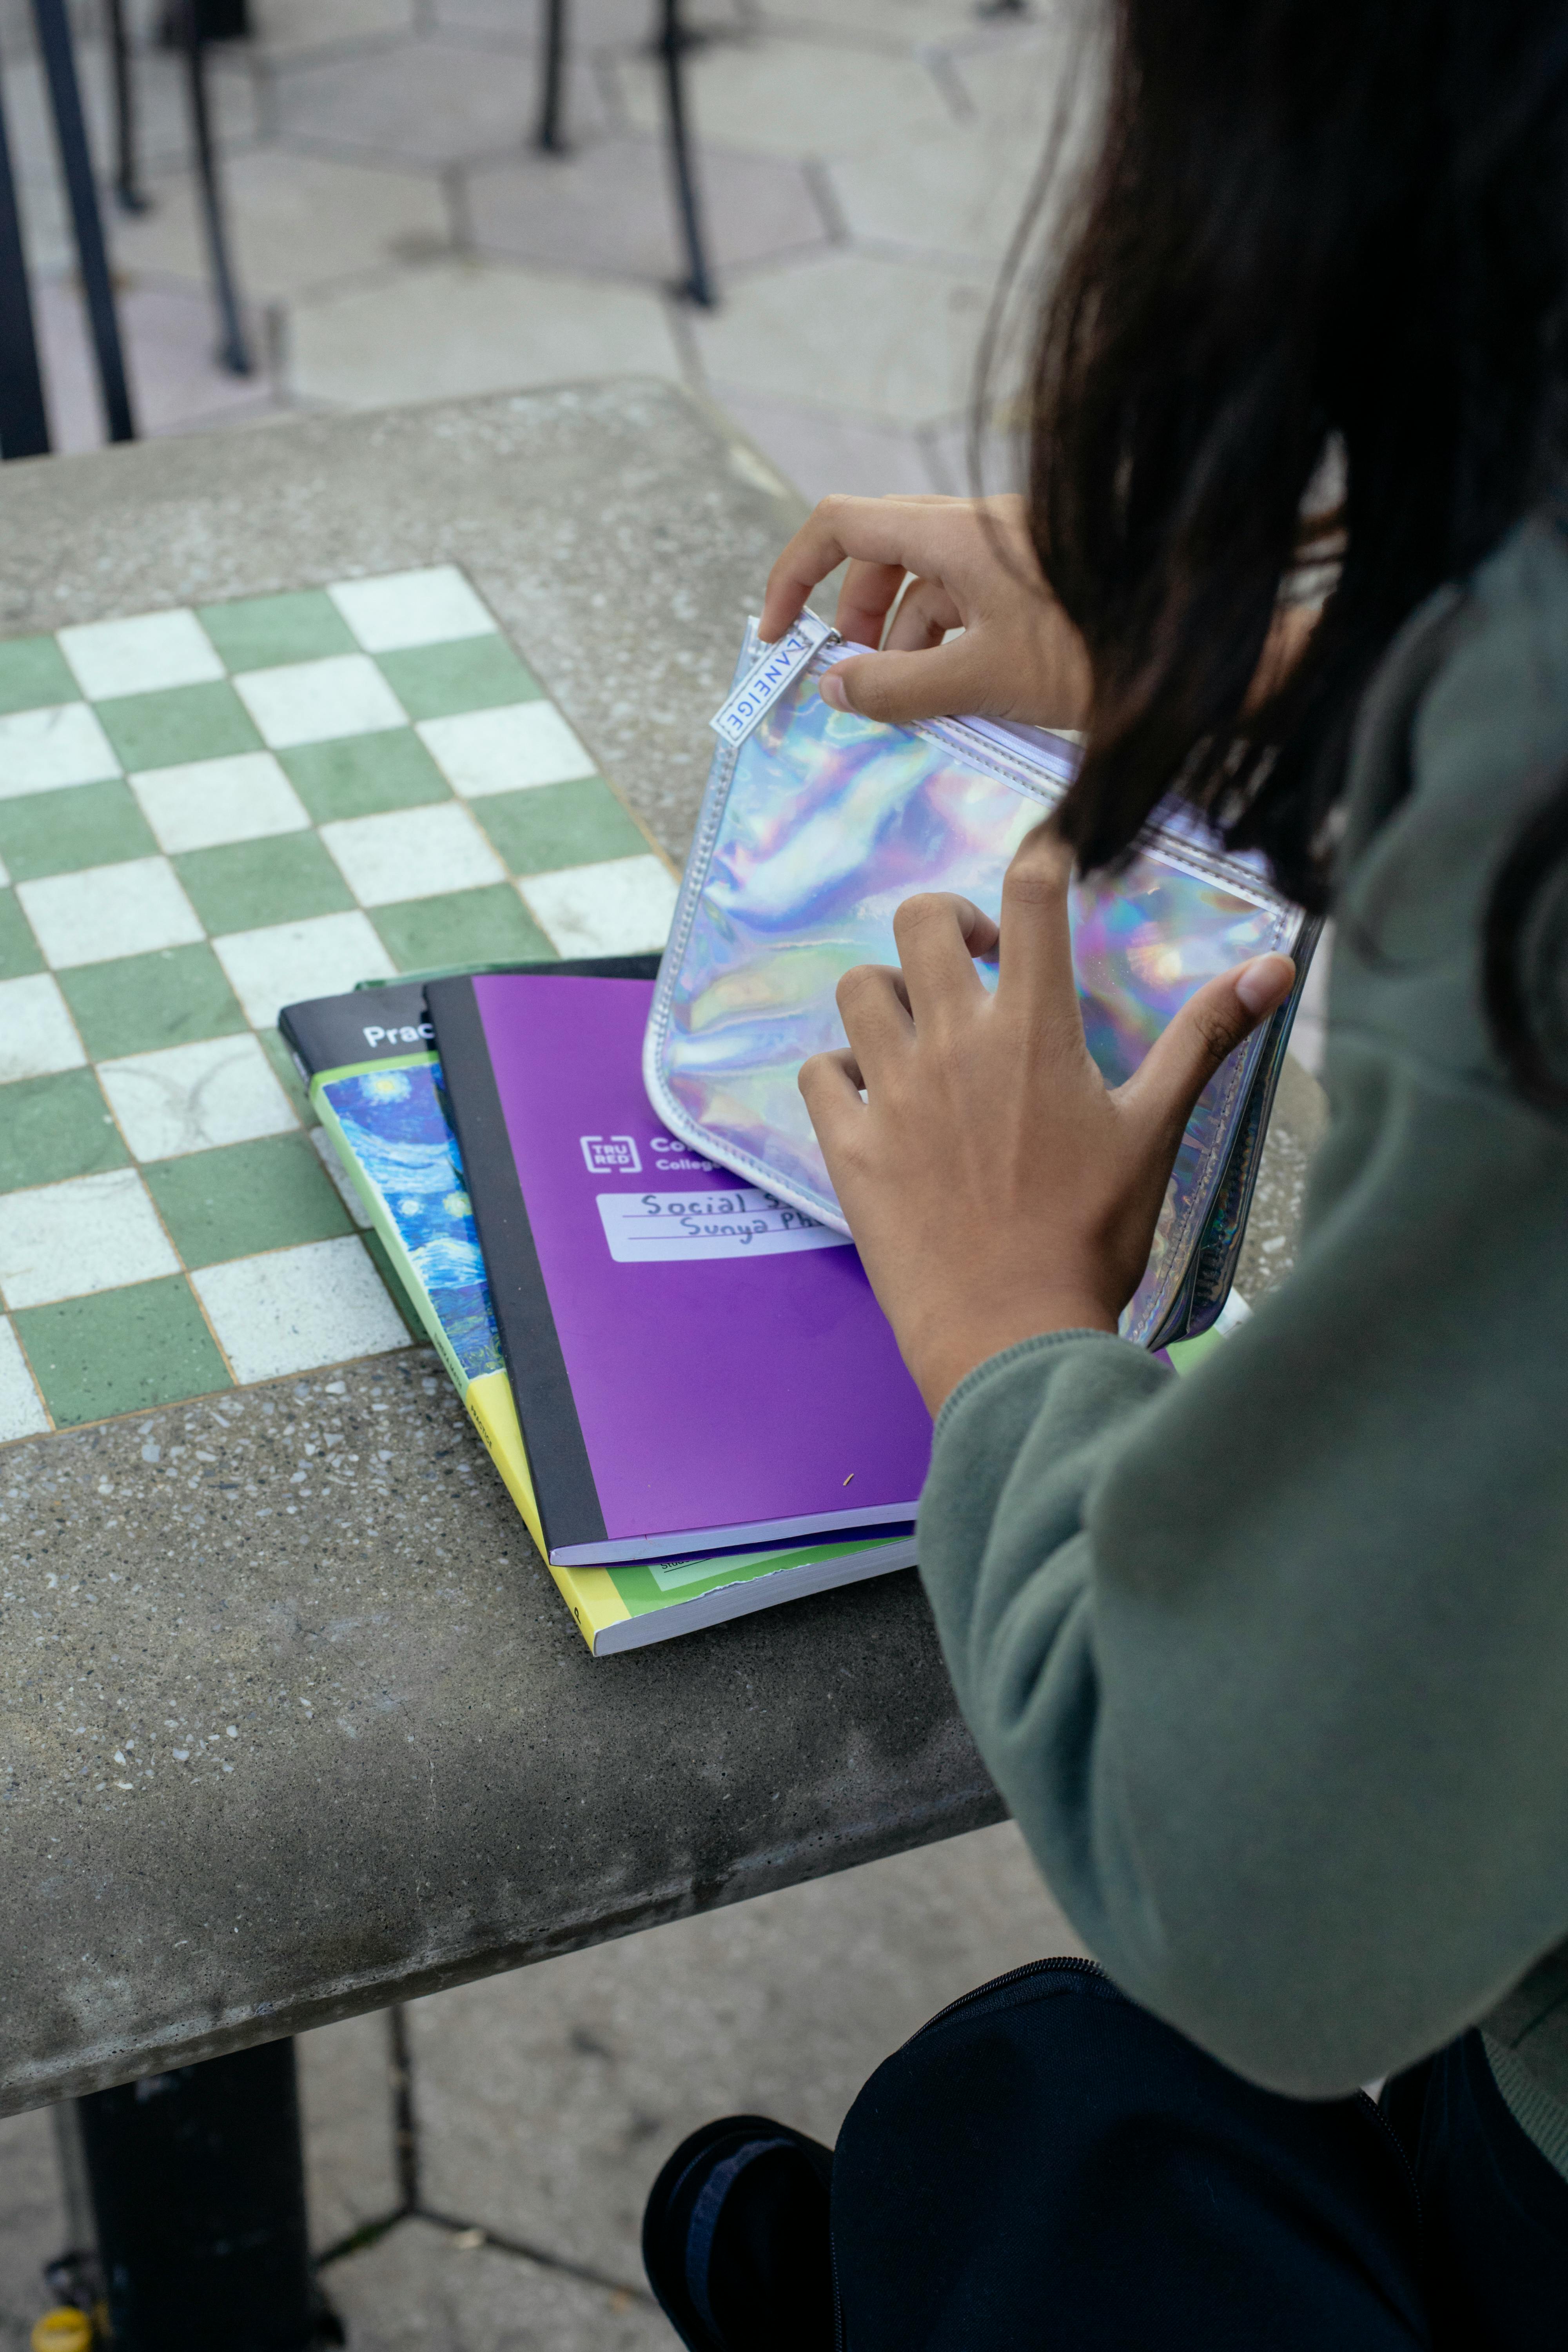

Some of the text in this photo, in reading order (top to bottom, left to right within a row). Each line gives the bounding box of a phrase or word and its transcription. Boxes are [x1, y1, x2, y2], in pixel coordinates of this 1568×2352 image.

[727, 638, 804, 730] LANEIGE
[591, 1144, 628, 1154] TRU
[594, 1155, 630, 1165] RED
[641, 1193, 746, 1215] Social
[680, 1217, 768, 1245] Sunya
[471, 1405, 492, 1449] PRACTICE
